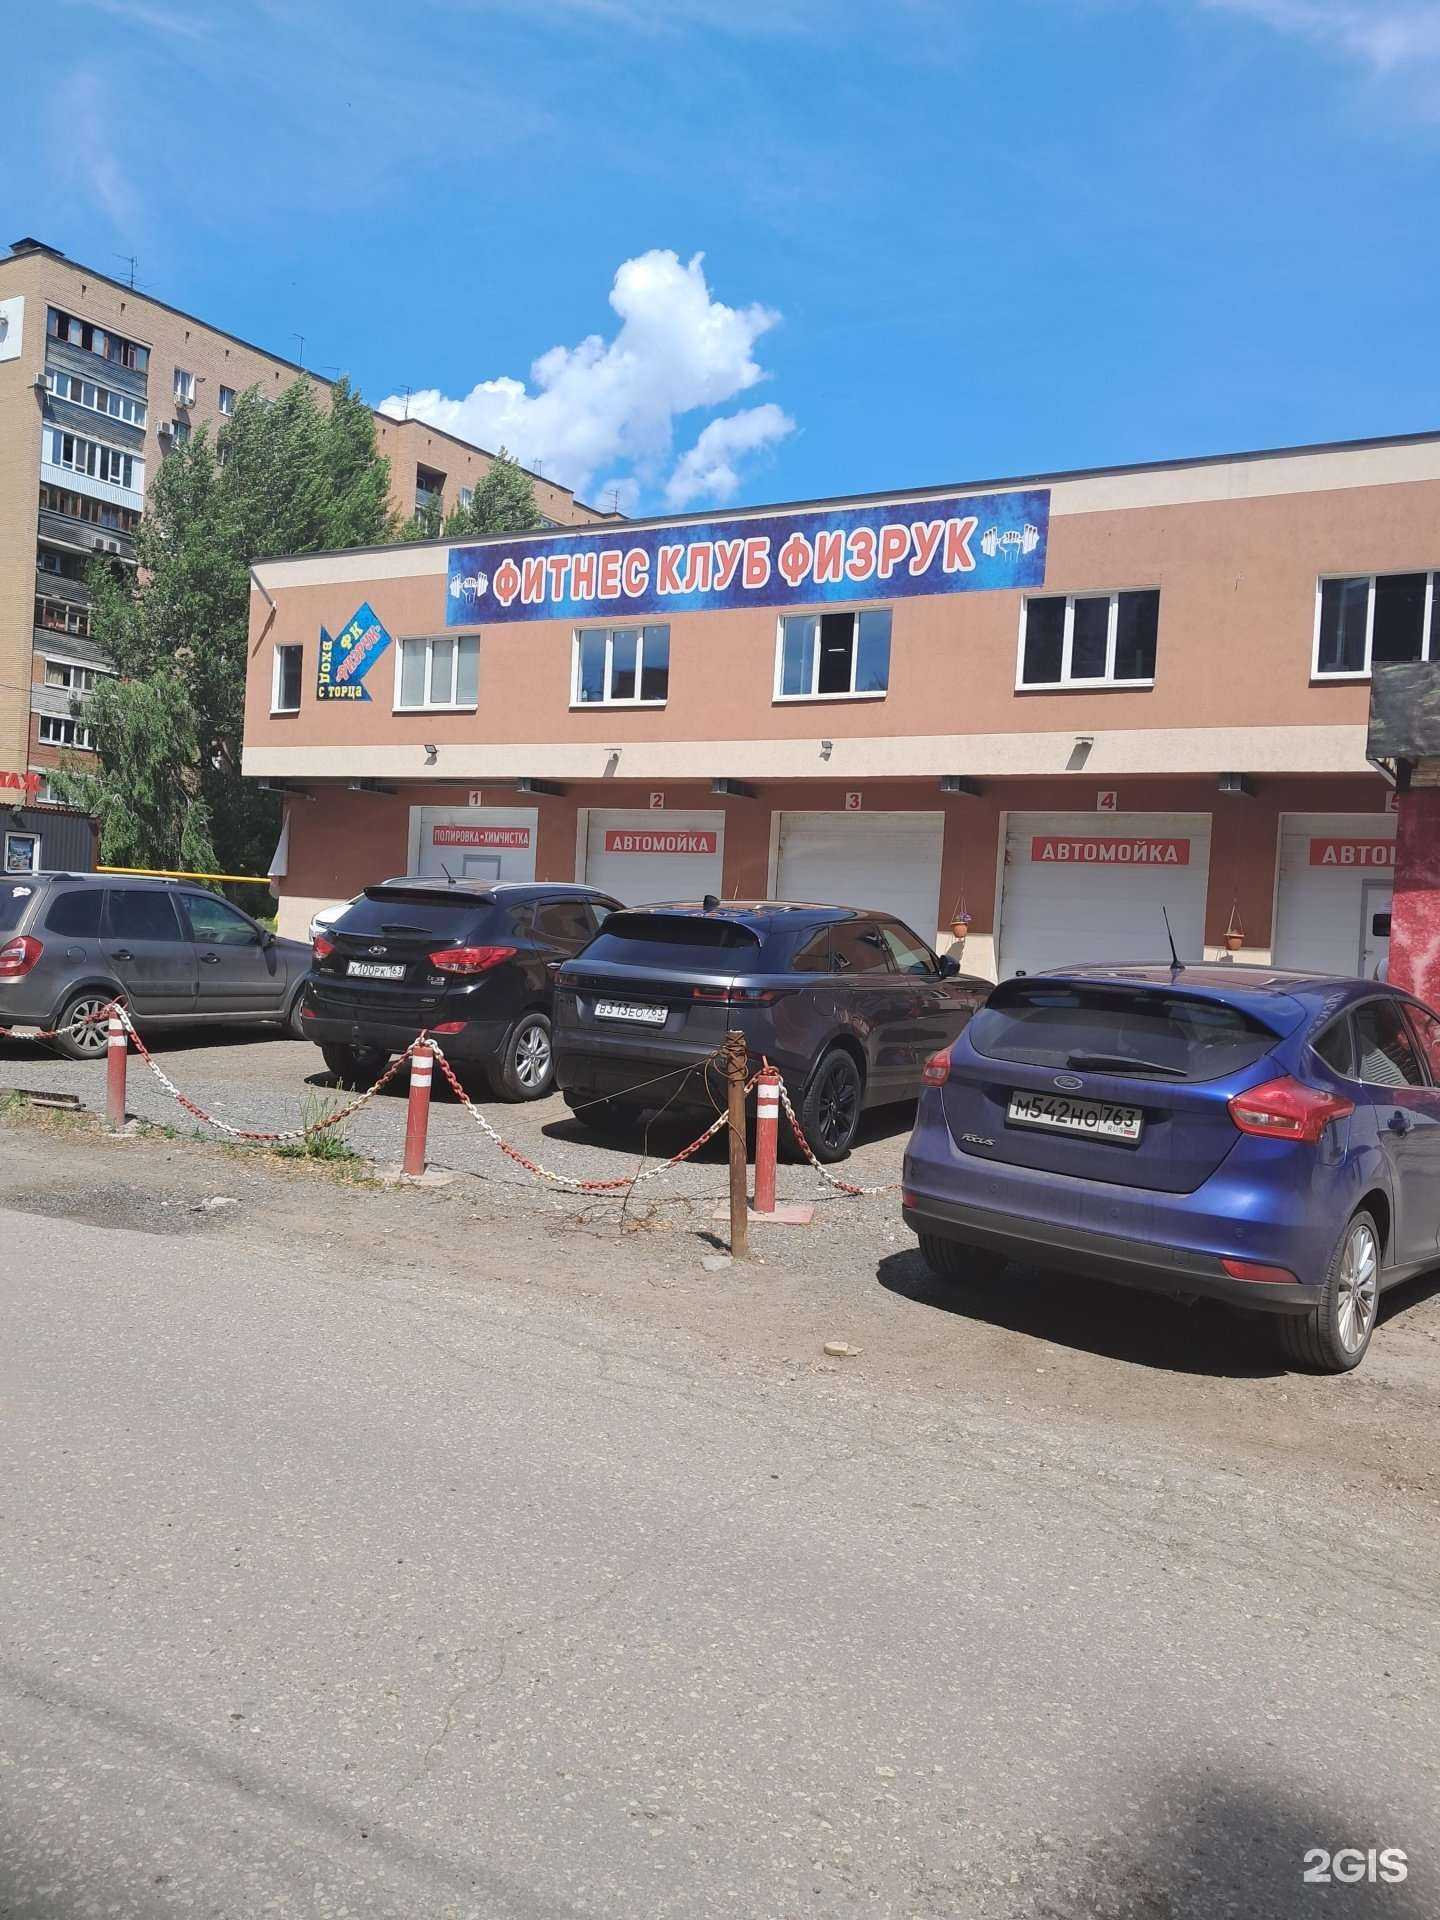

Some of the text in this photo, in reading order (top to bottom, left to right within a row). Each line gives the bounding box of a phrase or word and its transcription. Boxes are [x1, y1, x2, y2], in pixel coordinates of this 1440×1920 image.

[493, 517, 978, 607] ФИТНЕС КЛУБ ФИЗРУК
[319, 641, 332, 683] ВХОД
[653, 794, 663, 808] 2
[849, 794, 860, 808] 3
[1100, 793, 1115, 809] 4
[434, 830, 529, 845] ПОЛИРОВКА ХИМЧИСТКА
[612, 833, 709, 852] АВТОМОЙКА
[1042, 840, 1178, 862] АВТОМОЙКА
